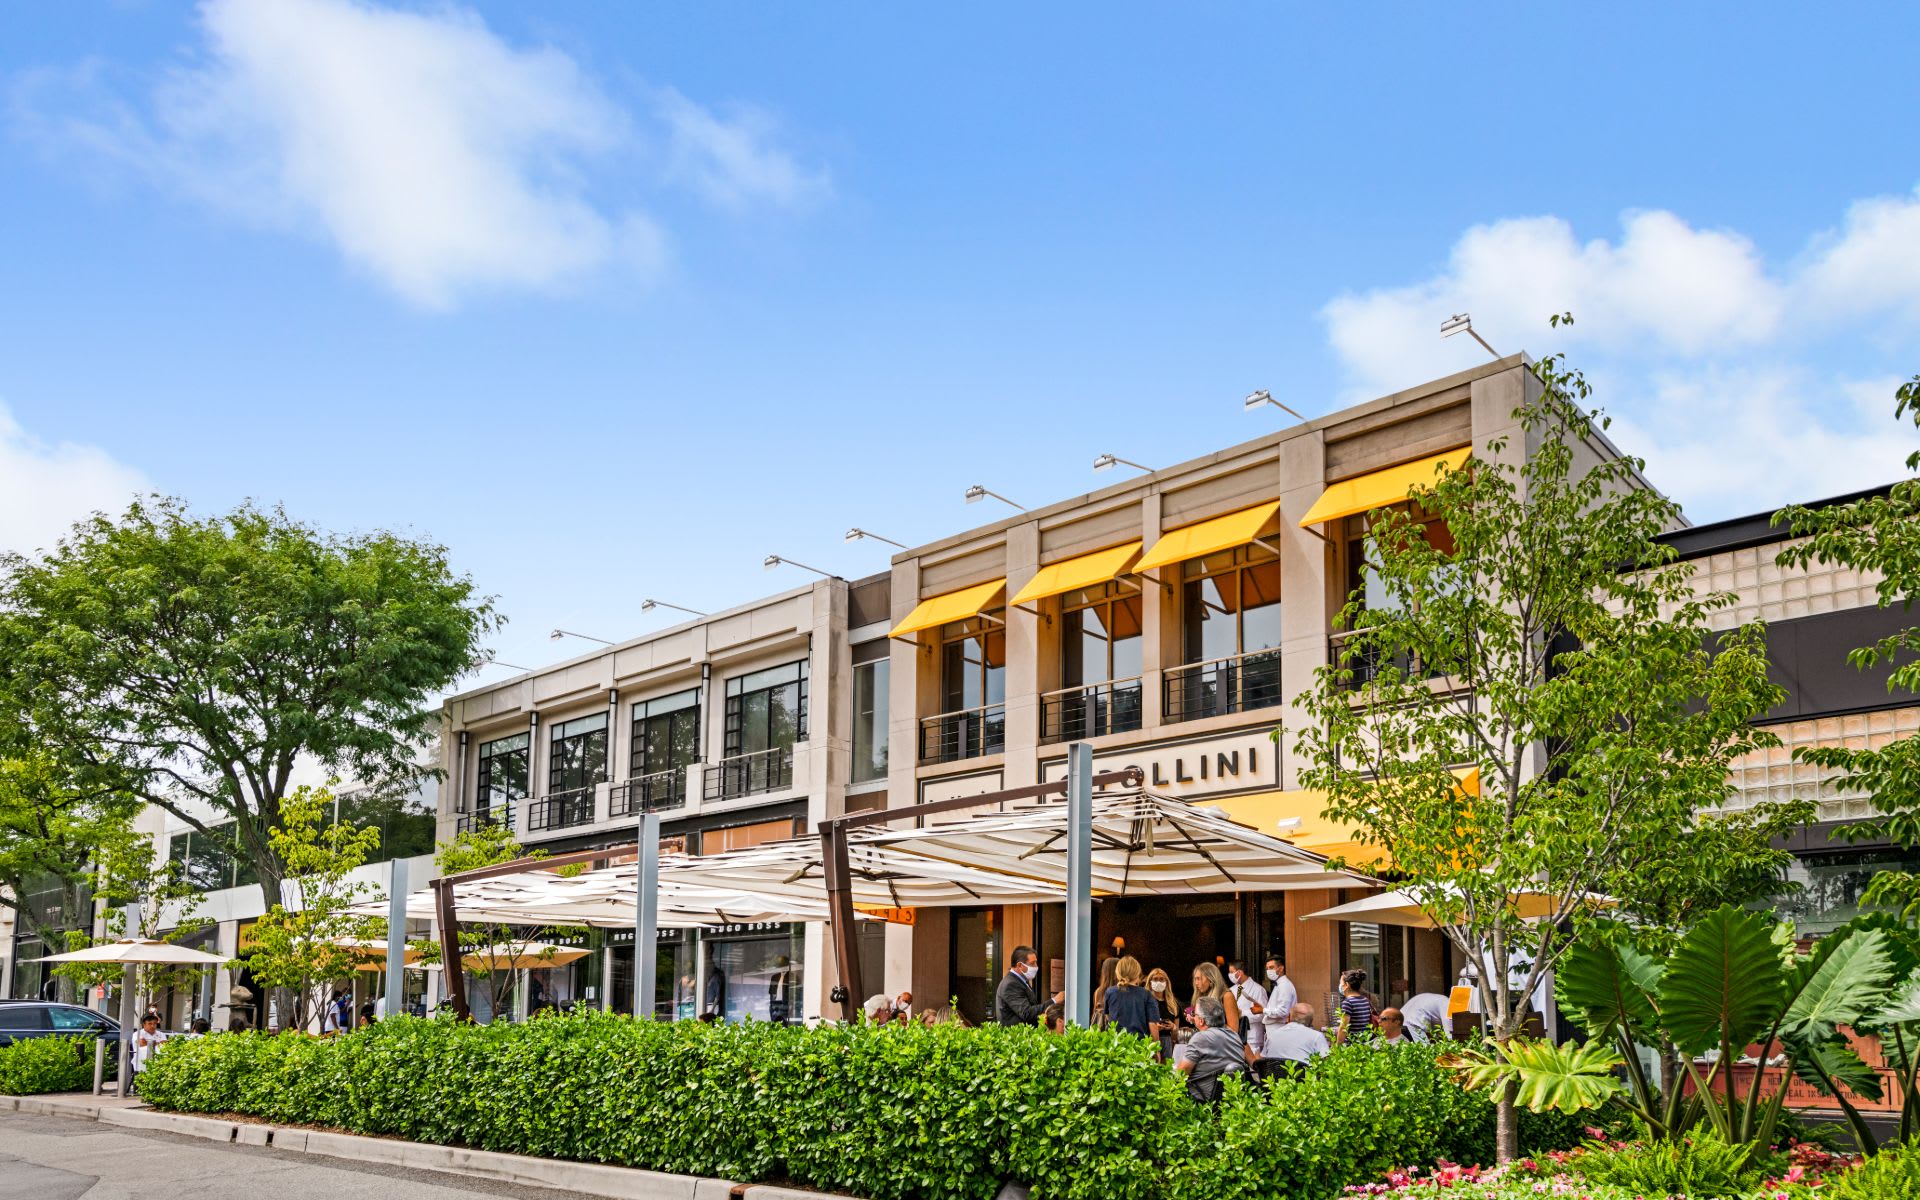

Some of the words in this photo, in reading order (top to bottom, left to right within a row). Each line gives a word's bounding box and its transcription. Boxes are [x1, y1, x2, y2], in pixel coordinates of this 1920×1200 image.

[1060, 748, 1257, 797] OLLINI
[710, 924, 741, 934] HUGO
[748, 921, 781, 931] BOSS
